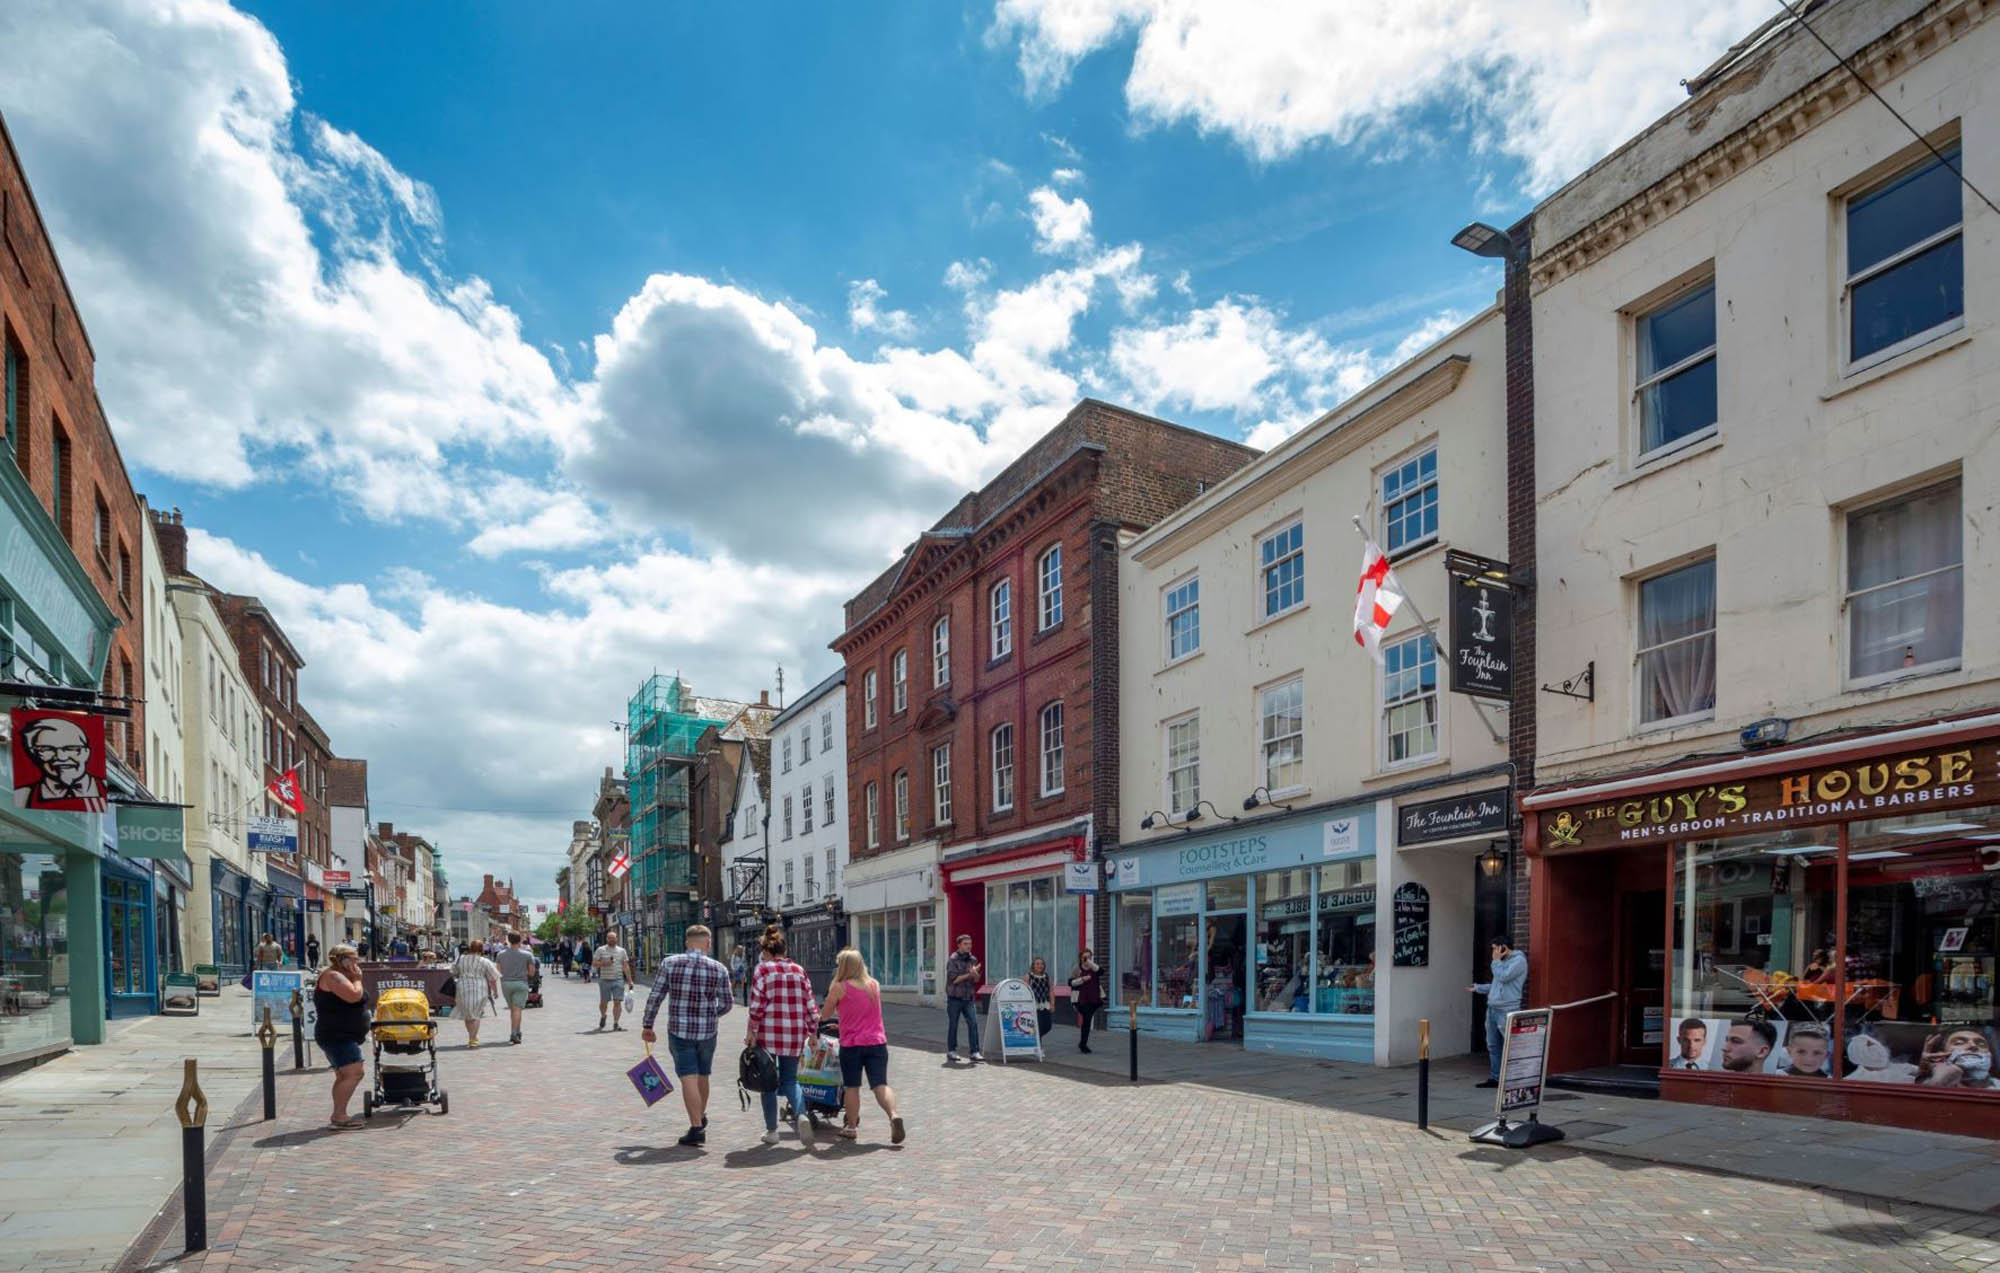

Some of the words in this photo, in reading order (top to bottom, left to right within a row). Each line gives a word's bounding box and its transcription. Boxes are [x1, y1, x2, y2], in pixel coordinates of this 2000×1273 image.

[1460, 649, 1508, 671] Fountain
[1474, 645, 1485, 656] The
[1476, 667, 1493, 680] Inn
[1585, 806, 1615, 820] THE
[1617, 785, 1747, 827] GUY'S
[1781, 750, 1973, 806] HOUSE
[1406, 812, 1426, 829] The
[1428, 806, 1477, 825] Fountain
[1478, 802, 1501, 817] Inn
[1621, 823, 1665, 840] MEN'S
[1669, 817, 1725, 833] GROOM
[1742, 798, 1868, 824] TRADITIONAL
[1875, 784, 1974, 807] BARBERS
[119, 825, 181, 842] SHOES
[1180, 836, 1267, 864] FOOTSTEPS
[1180, 861, 1230, 876] Counselling
[1233, 856, 1241, 867] &
[1243, 855, 1267, 866] Care
[377, 980, 425, 989] HUBBLE
